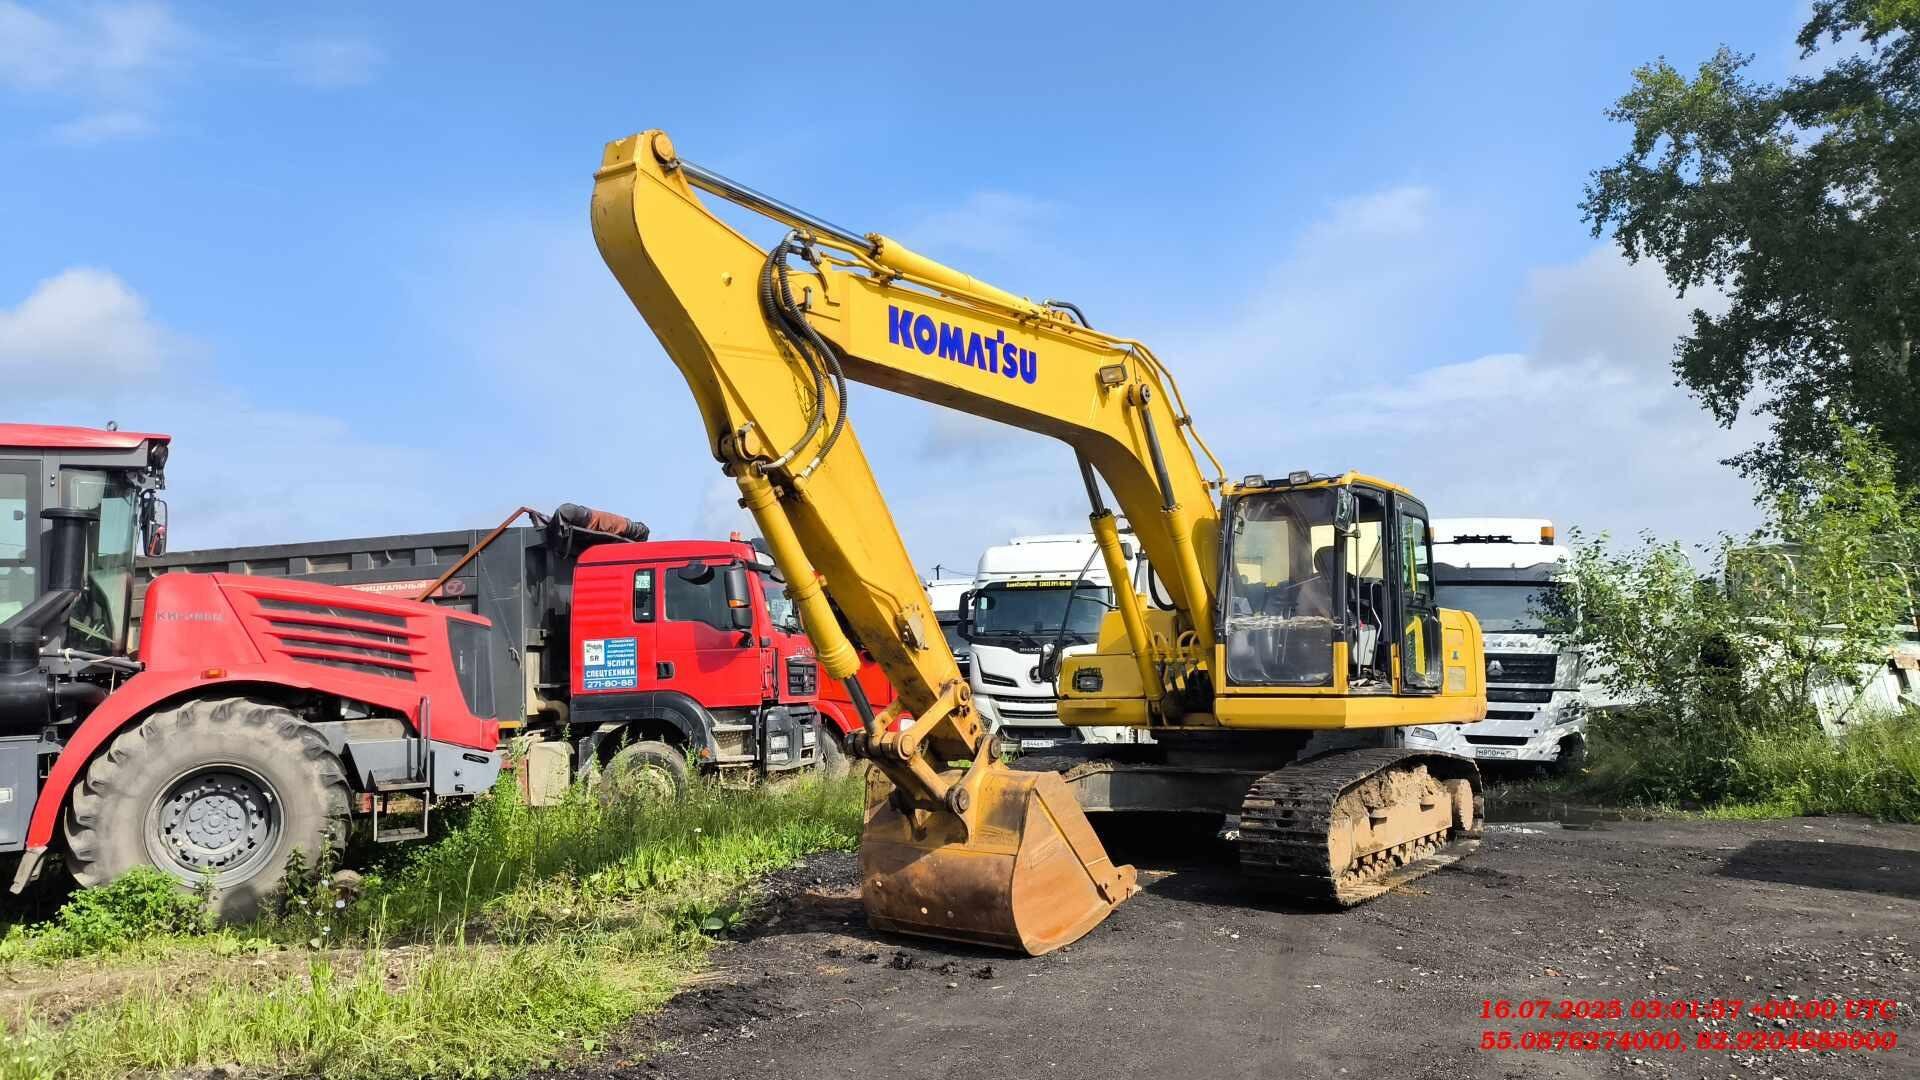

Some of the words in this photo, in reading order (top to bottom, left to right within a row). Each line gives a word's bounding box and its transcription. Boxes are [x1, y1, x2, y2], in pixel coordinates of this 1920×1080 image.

[888, 304, 1037, 384] KOMATSU
[607, 659, 635, 667] УСЛУГИ
[586, 669, 635, 678] СПЕЦТЕХНИКИ
